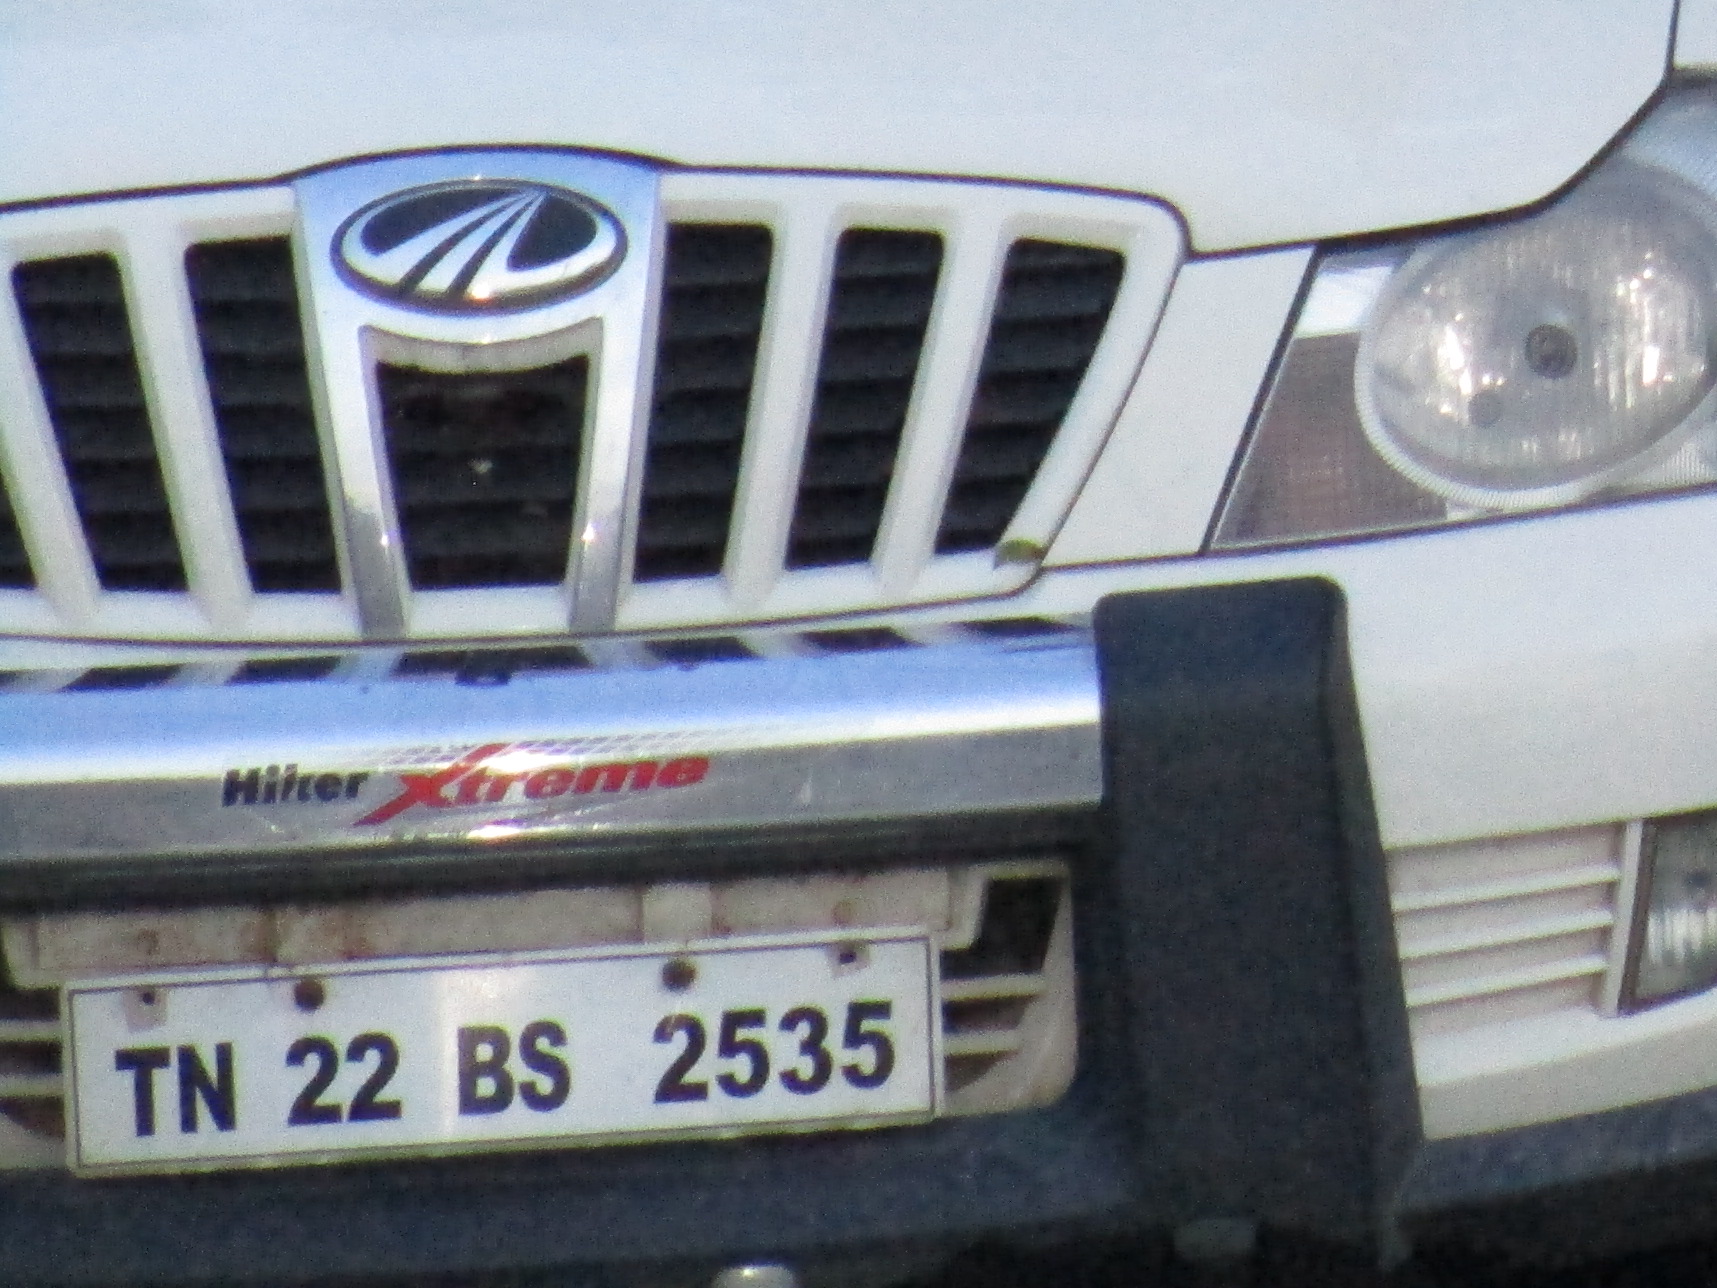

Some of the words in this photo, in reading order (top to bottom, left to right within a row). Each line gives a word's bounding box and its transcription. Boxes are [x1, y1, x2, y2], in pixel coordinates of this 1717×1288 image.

[353, 742, 710, 826] Xtreme
[115, 1041, 236, 1137] TN
[285, 1032, 402, 1126] 22
[456, 1020, 571, 1116] BS
[652, 999, 895, 1104] 2535
